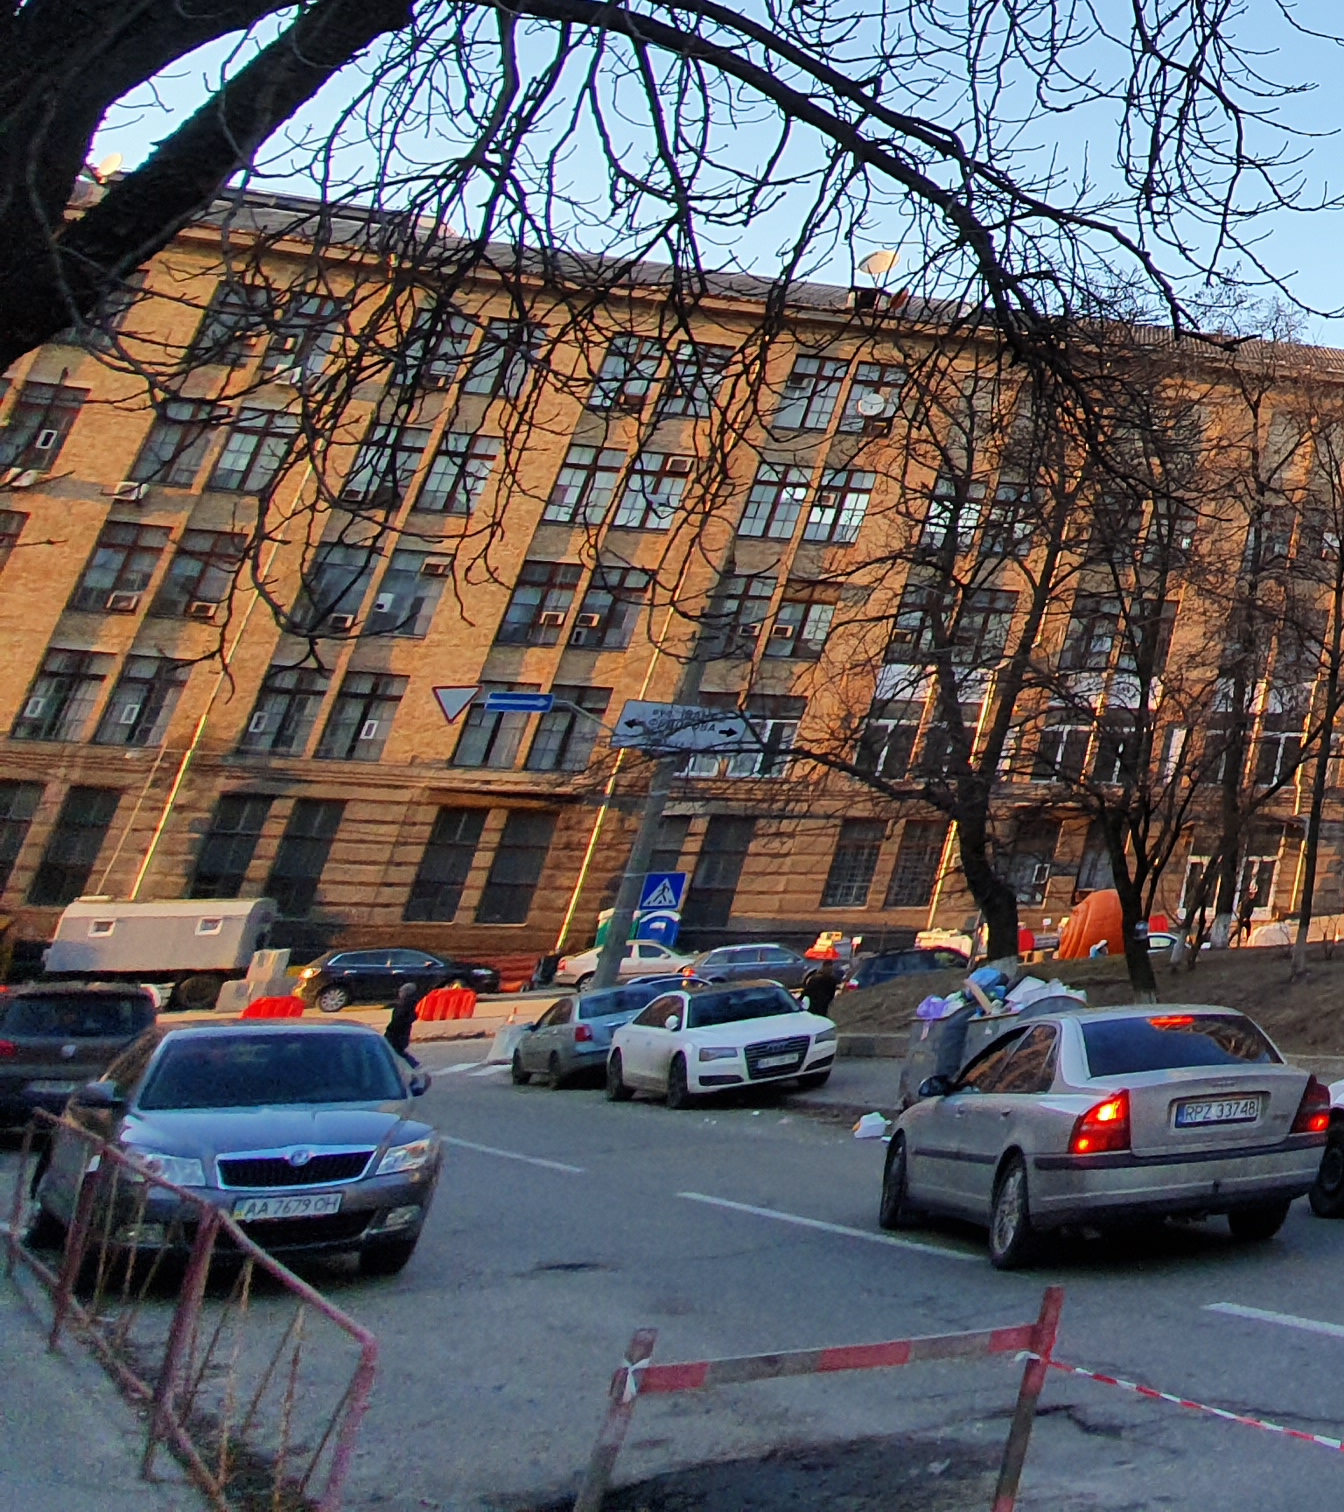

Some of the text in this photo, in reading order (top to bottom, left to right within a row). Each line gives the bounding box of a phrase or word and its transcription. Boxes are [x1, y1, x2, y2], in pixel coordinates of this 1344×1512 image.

[1185, 1105, 1212, 1121] RPZ
[1216, 1101, 1256, 1118] 33748
[245, 1201, 269, 1216] AA
[274, 1198, 312, 1215] 7679
